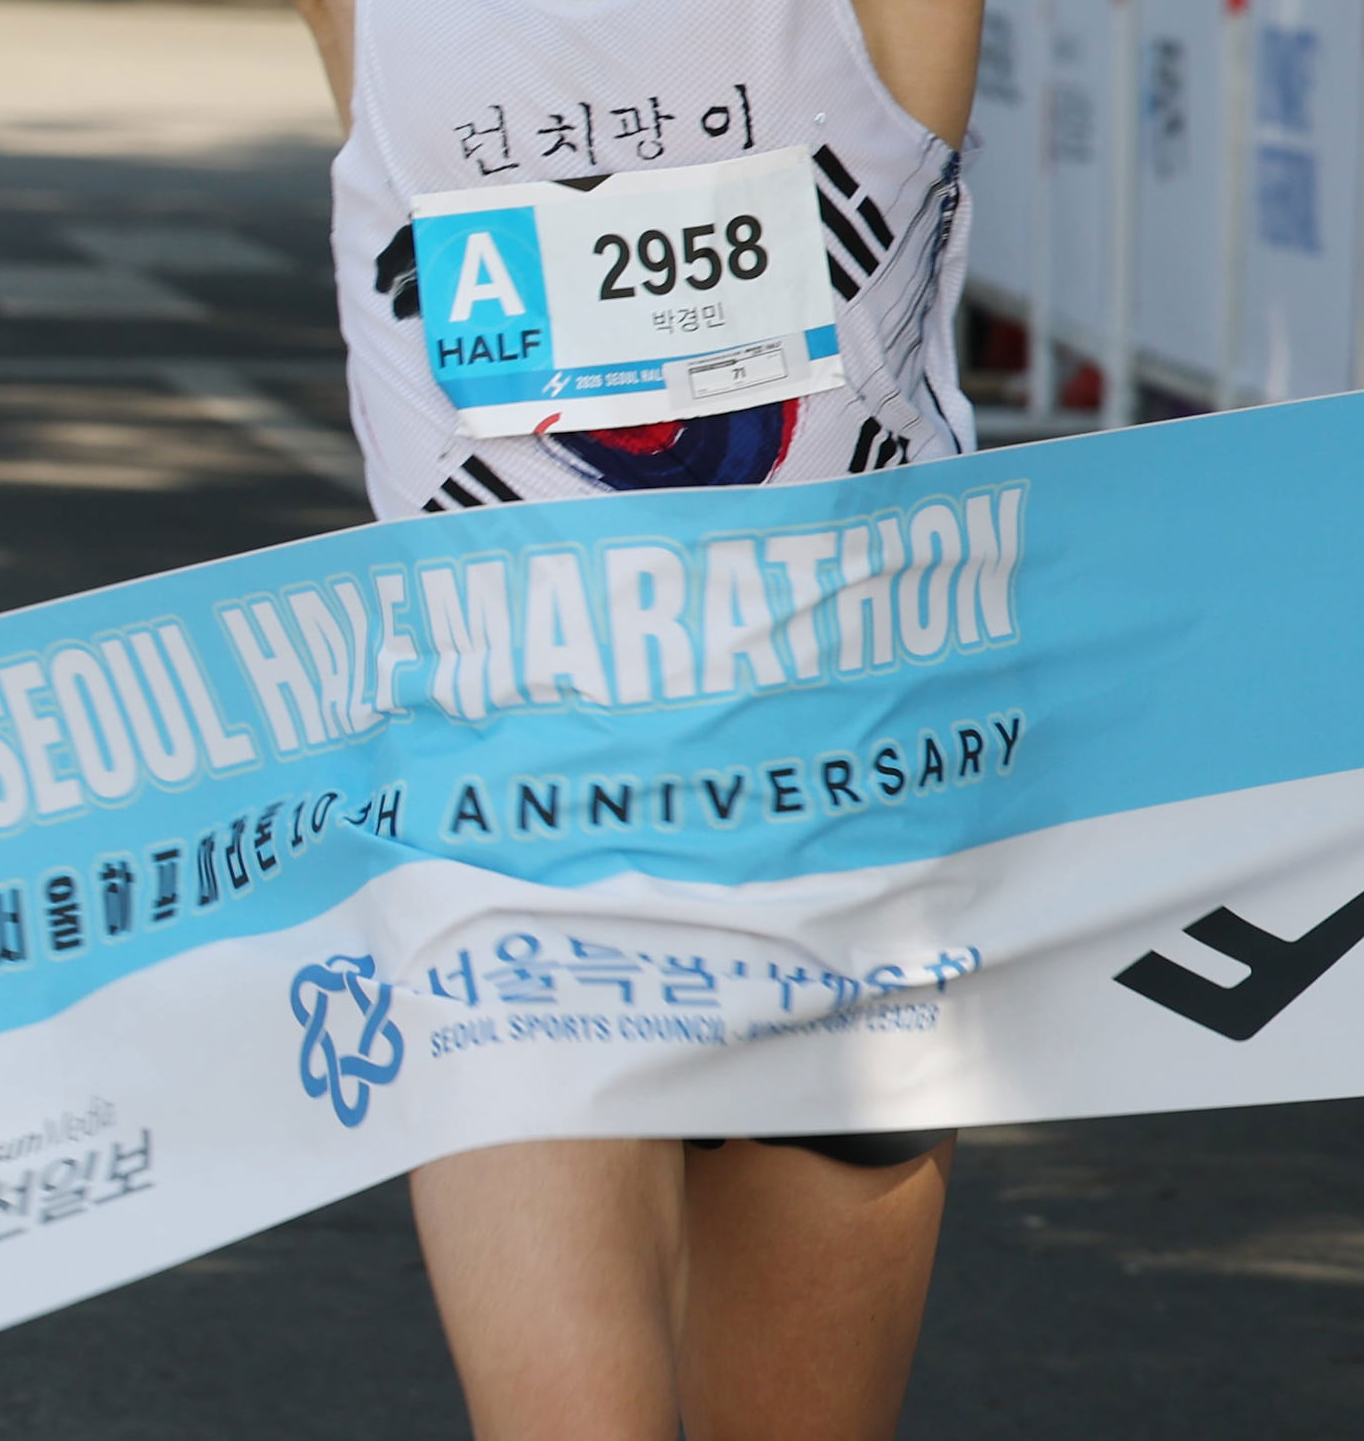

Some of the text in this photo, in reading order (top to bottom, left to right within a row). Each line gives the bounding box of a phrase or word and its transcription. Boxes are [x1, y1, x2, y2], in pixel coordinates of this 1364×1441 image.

[448, 232, 526, 324] A
[592, 213, 769, 303] 2958
[437, 329, 541, 369] HALF
[650, 302, 726, 333] 박경민
[221, 573, 419, 754] HALF
[423, 487, 1024, 720] MARATHON
[451, 716, 1022, 834] ANNIVERSARY
[431, 1019, 499, 1058] SEOUL
[509, 1011, 612, 1047] SPORTS
